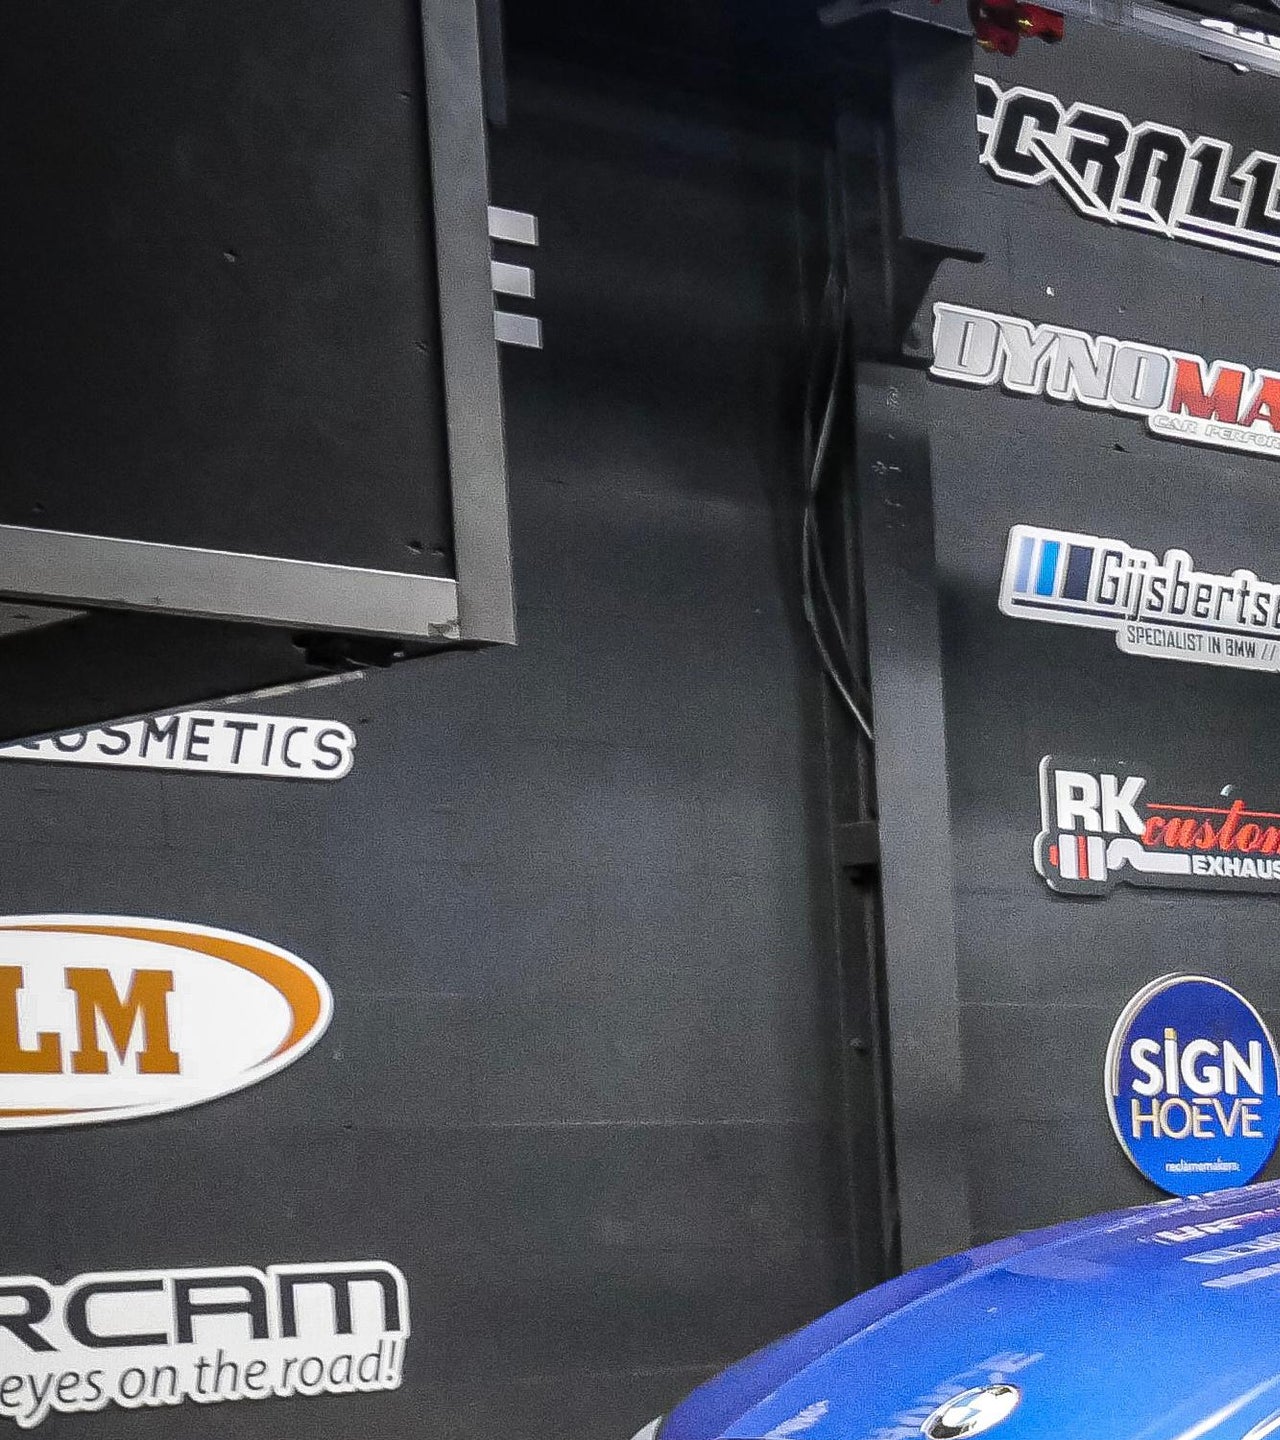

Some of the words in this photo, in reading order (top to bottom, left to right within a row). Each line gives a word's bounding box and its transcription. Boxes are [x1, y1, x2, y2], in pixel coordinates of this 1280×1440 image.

[1153, 415, 1198, 433] CAR
[1127, 625, 1203, 651] SPECIALIST
[1208, 636, 1221, 654] IN
[1225, 638, 1256, 659] BMW
[20, 716, 348, 770] SMETICS
[1055, 769, 1146, 835] RK
[1131, 1097, 1264, 1139] HOEVE
[118, 1365, 180, 1401] on
[196, 1348, 268, 1395] the
[282, 1337, 402, 1389] road!
